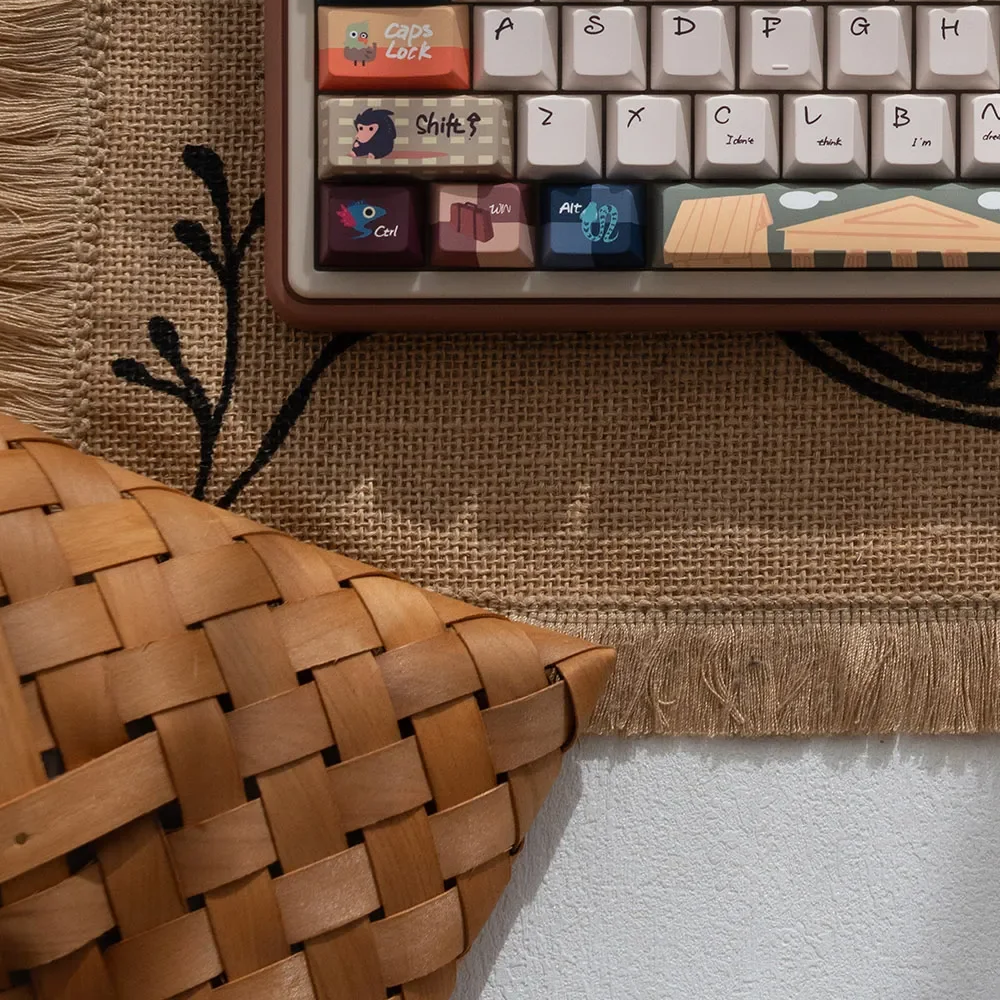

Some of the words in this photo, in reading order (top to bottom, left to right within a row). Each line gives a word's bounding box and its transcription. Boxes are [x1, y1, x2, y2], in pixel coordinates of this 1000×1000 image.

[495, 16, 514, 40] A
[583, 15, 605, 34] S
[673, 16, 696, 35] D
[762, 17, 781, 38] F
[850, 17, 870, 35] G
[941, 17, 959, 39] H
[627, 107, 645, 128] X
[714, 105, 731, 124] C
[892, 106, 911, 128] B
[416, 112, 465, 138] Shift
[726, 134, 734, 145] I
[733, 135, 755, 145] don't
[817, 136, 843, 146] think
[911, 137, 932, 147] I'm
[559, 201, 582, 214] Alt
[374, 225, 397, 238] Ctrl
